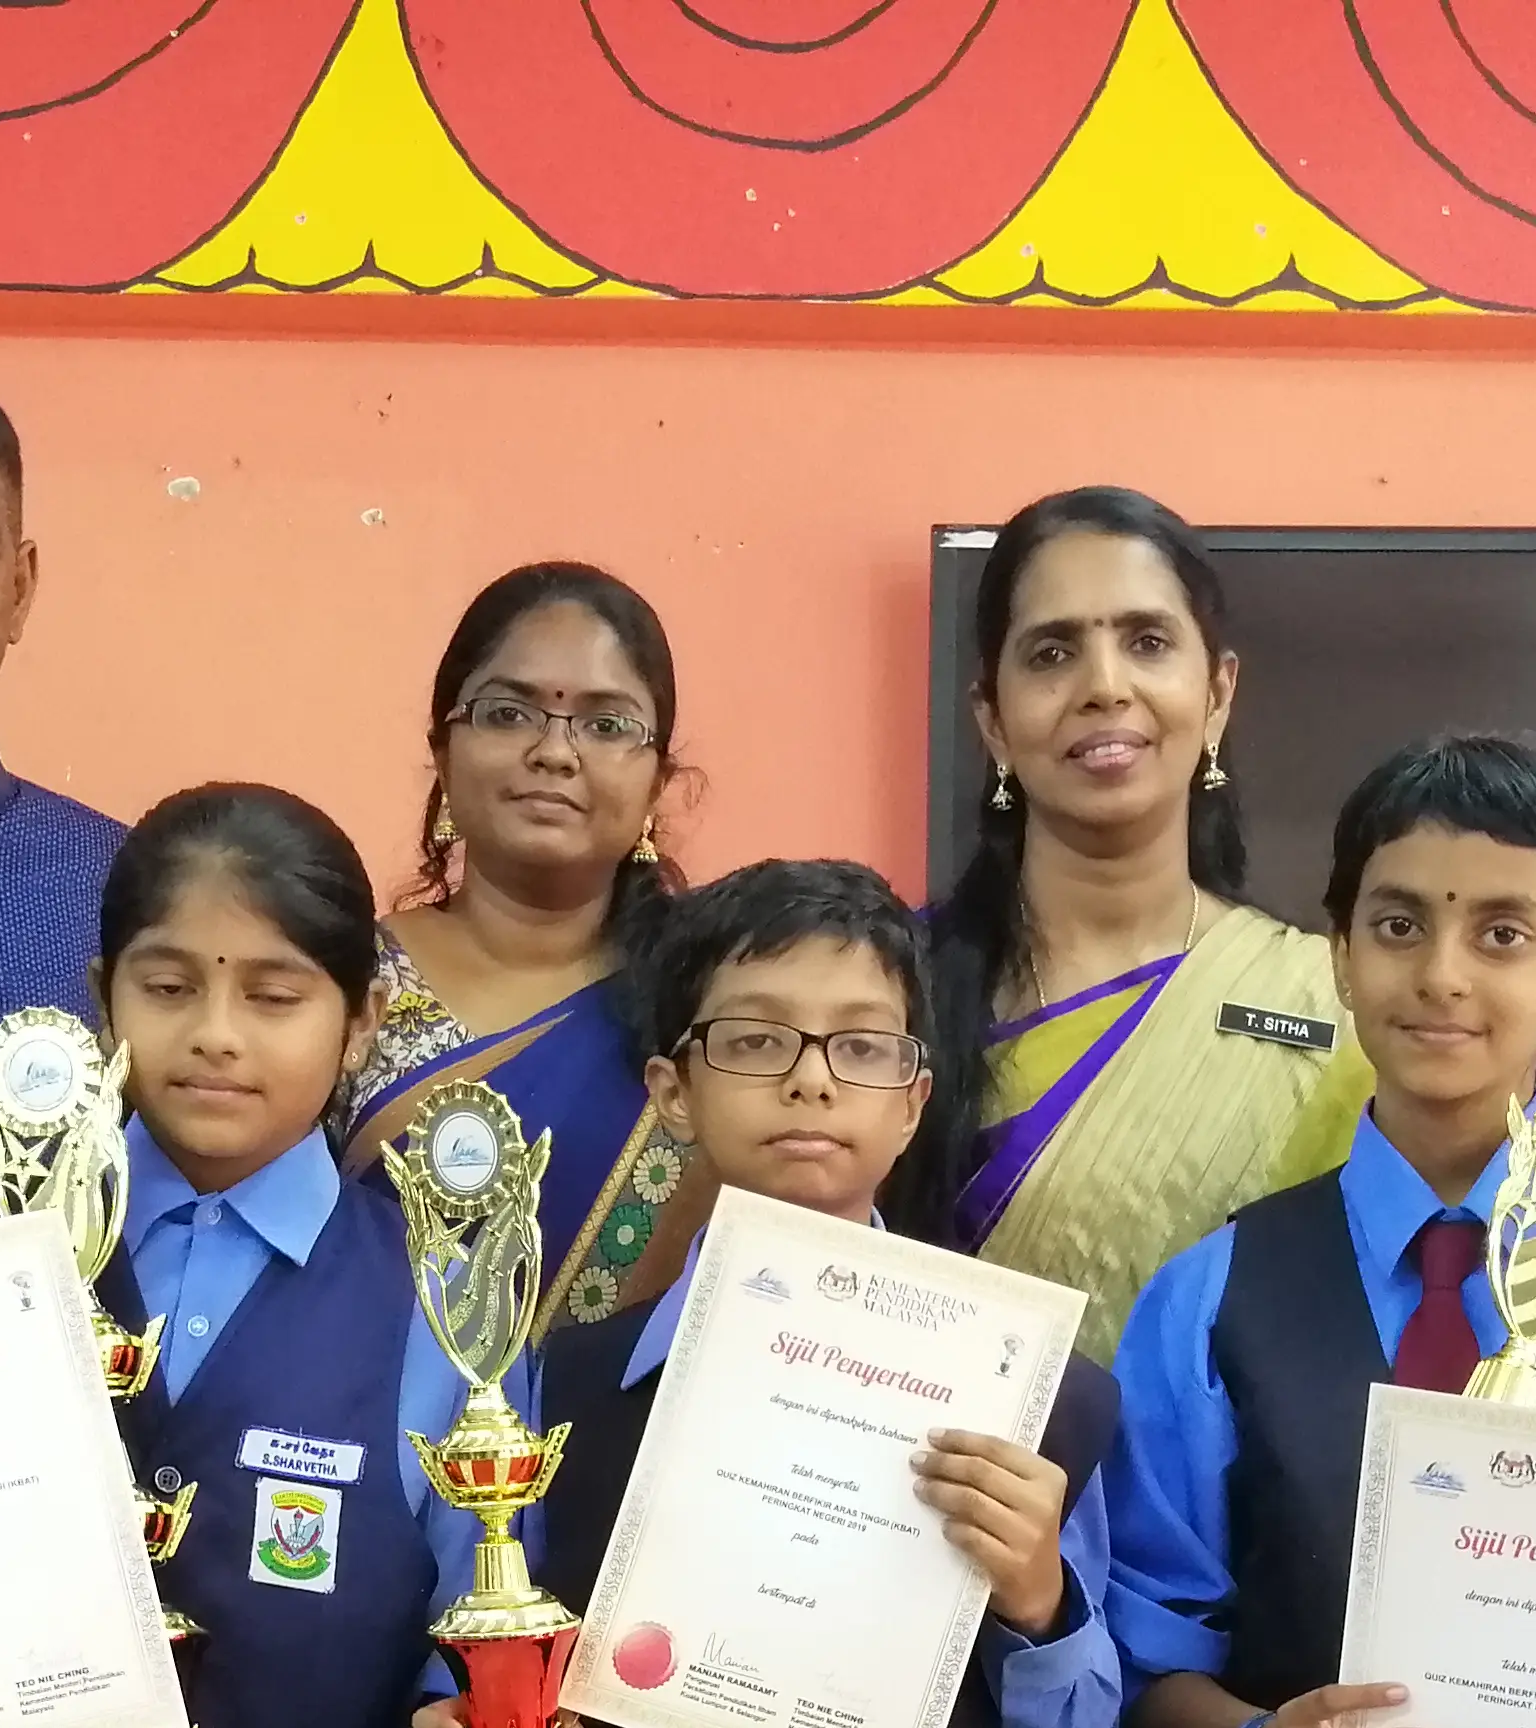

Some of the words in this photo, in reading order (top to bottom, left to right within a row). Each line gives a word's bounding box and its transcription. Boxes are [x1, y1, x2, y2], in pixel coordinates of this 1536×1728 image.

[1245, 1013, 1259, 1028] T.
[1264, 1017, 1309, 1038] SITHA
[864, 1285, 956, 1323] PENDIDIKAN
[869, 1273, 976, 1315] KEMENTERIAN
[863, 1298, 937, 1331] MALAYSIA
[769, 1331, 820, 1364] Sijil
[822, 1346, 952, 1403] Penyertaan
[262, 1453, 338, 1477] S.SHARVETHA
[716, 1468, 737, 1480] QUIZ
[738, 1475, 790, 1496] KEMAHIRAN
[791, 1491, 832, 1509] BERFIKIR
[832, 1504, 857, 1517] ARAS
[860, 1511, 889, 1526] TINGGI
[890, 1521, 920, 1537] (KBAT)
[761, 1494, 811, 1515] PERINGKAT
[812, 1509, 845, 1525] NEGERI
[846, 1520, 866, 1532] 2019
[1454, 1525, 1506, 1559] Sijil
[688, 1664, 724, 1680] MANIAN
[726, 1676, 778, 1697] RAMASAMY
[1424, 1672, 1446, 1683] QUIZ
[1448, 1676, 1505, 1693] KEMAHIRAN
[797, 1697, 814, 1709] TEO
[816, 1704, 832, 1714] NIE
[834, 1710, 863, 1724] CHING
[1477, 1693, 1532, 1709] PERINGKAT
